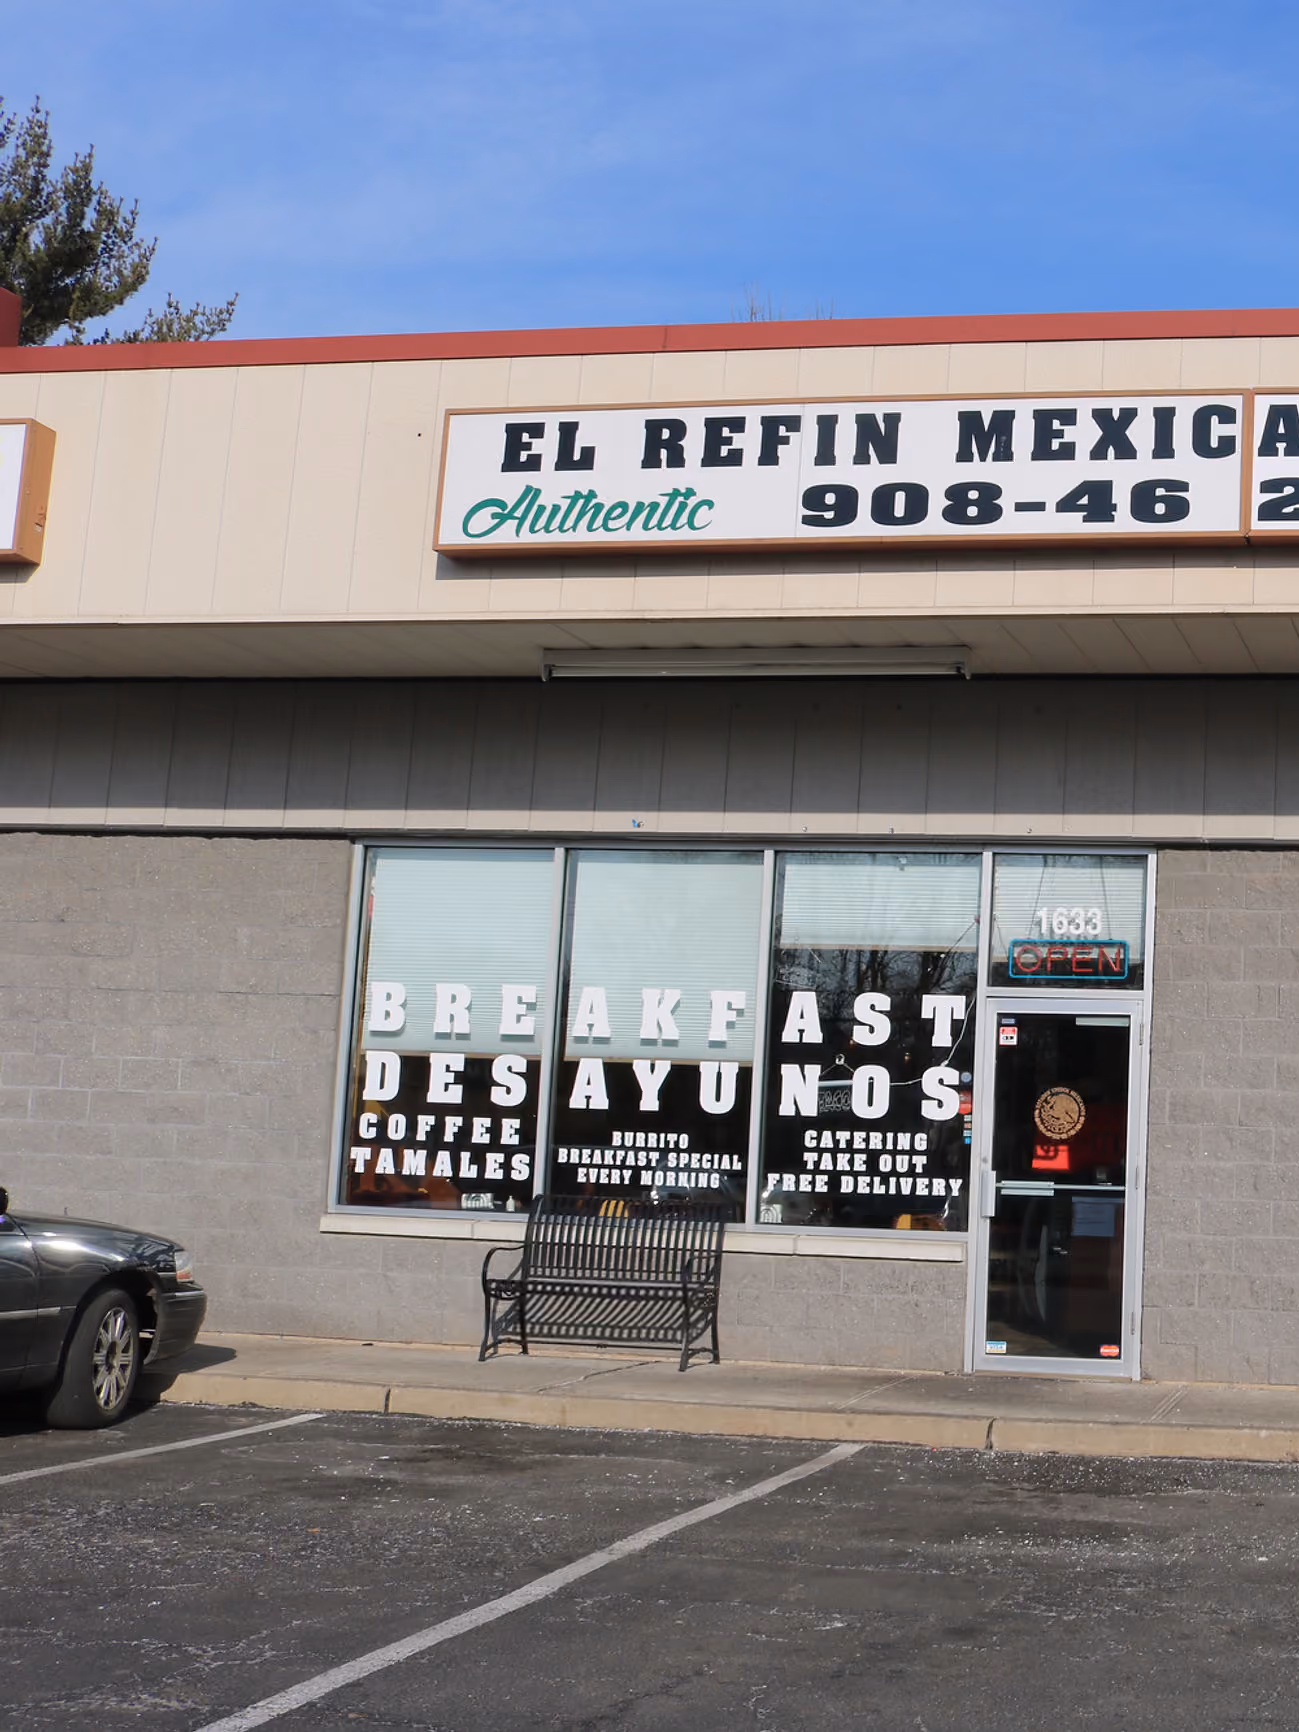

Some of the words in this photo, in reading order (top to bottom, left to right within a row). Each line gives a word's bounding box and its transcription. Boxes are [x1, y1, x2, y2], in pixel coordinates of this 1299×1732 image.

[501, 422, 596, 473] EL
[641, 412, 902, 470] REFIN
[461, 484, 715, 540] Authentic
[1037, 906, 1102, 934] 1633
[1015, 945, 1121, 973] OPEN
[368, 981, 967, 1047] BREAKFAST
[362, 1050, 961, 1121] DESAYUNOS
[358, 1113, 522, 1146] COFFEE
[611, 1131, 689, 1150] BURRITO
[804, 1130, 928, 1151] CATERING
[350, 1146, 531, 1182] TAMALES
[557, 1148, 660, 1168] BREAKFAST
[667, 1153, 743, 1171] SPECIAL
[803, 1155, 867, 1172] TAKE
[879, 1156, 928, 1174] OUT
[576, 1171, 632, 1186] EVERY
[640, 1174, 722, 1190] MORNING
[766, 1173, 829, 1194] FREE
[840, 1176, 964, 1197] DELIVERY
